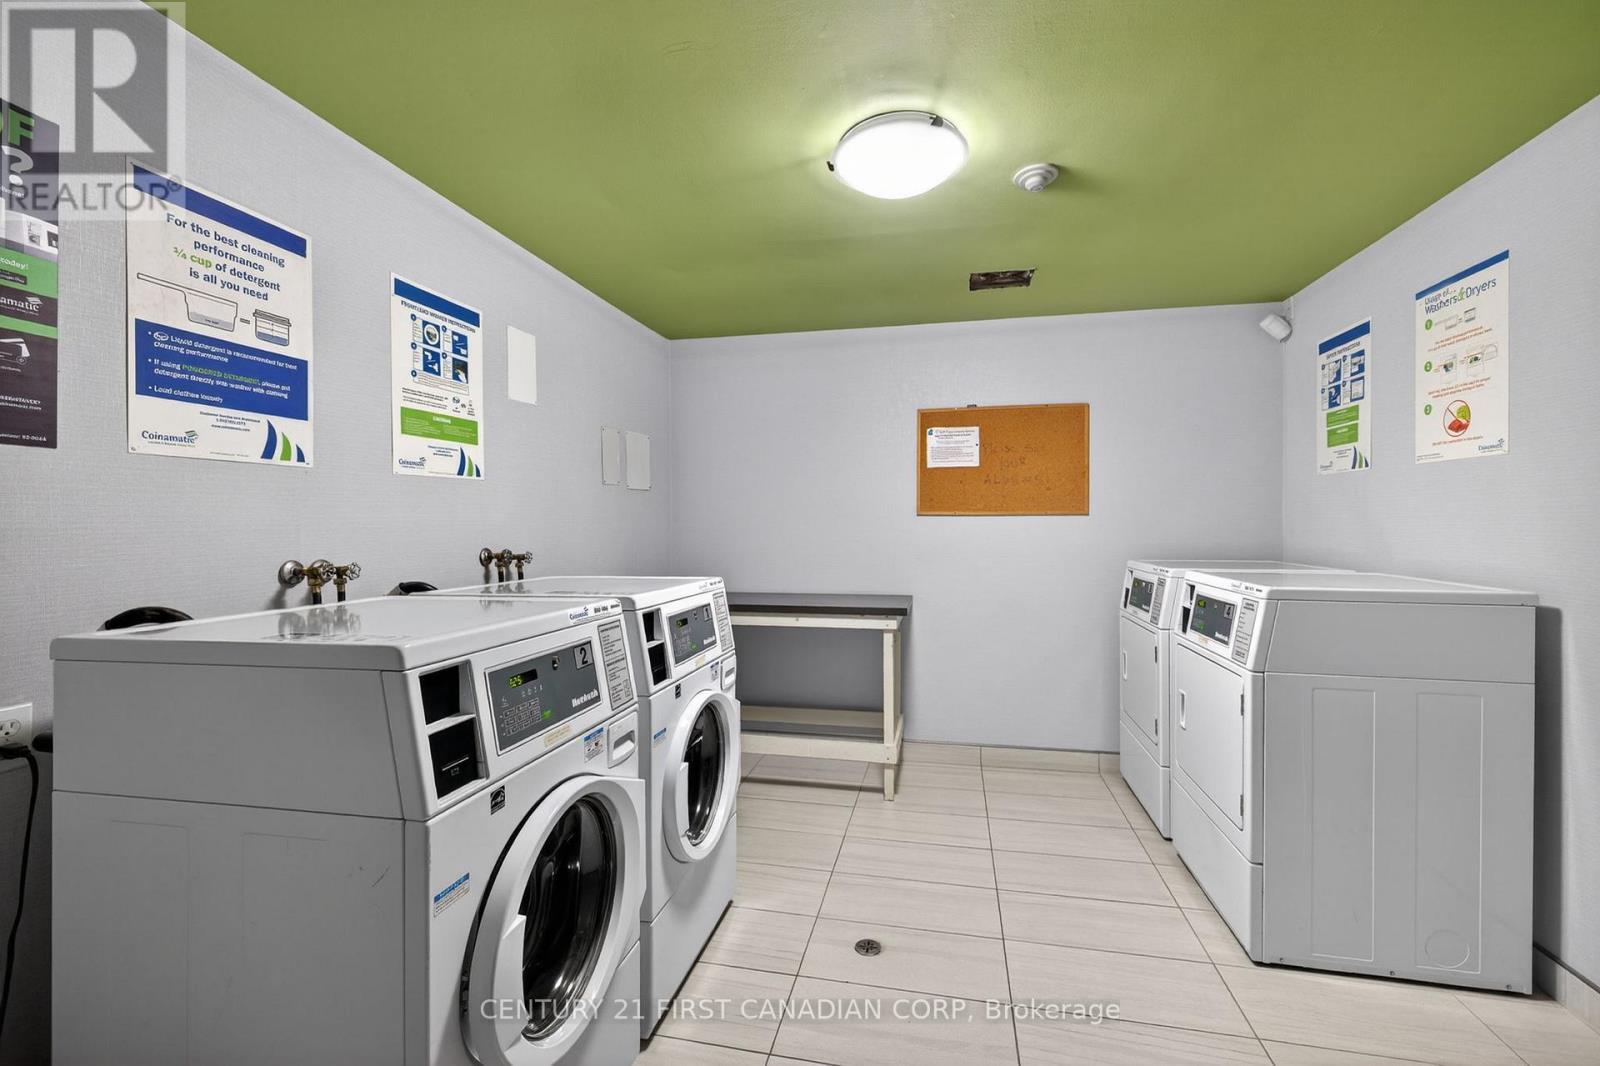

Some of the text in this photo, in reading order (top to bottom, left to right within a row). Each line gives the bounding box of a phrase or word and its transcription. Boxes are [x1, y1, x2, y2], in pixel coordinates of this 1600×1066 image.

[166, 213, 286, 268] For the best cleaning
[193, 240, 265, 272] performance
[189, 267, 269, 301] is all you need
[190, 254, 212, 269] cup
[215, 261, 227, 273] of
[229, 265, 281, 292] detergent
[141, 430, 197, 444] Coinamatic
[578, 646, 588, 666] 2
